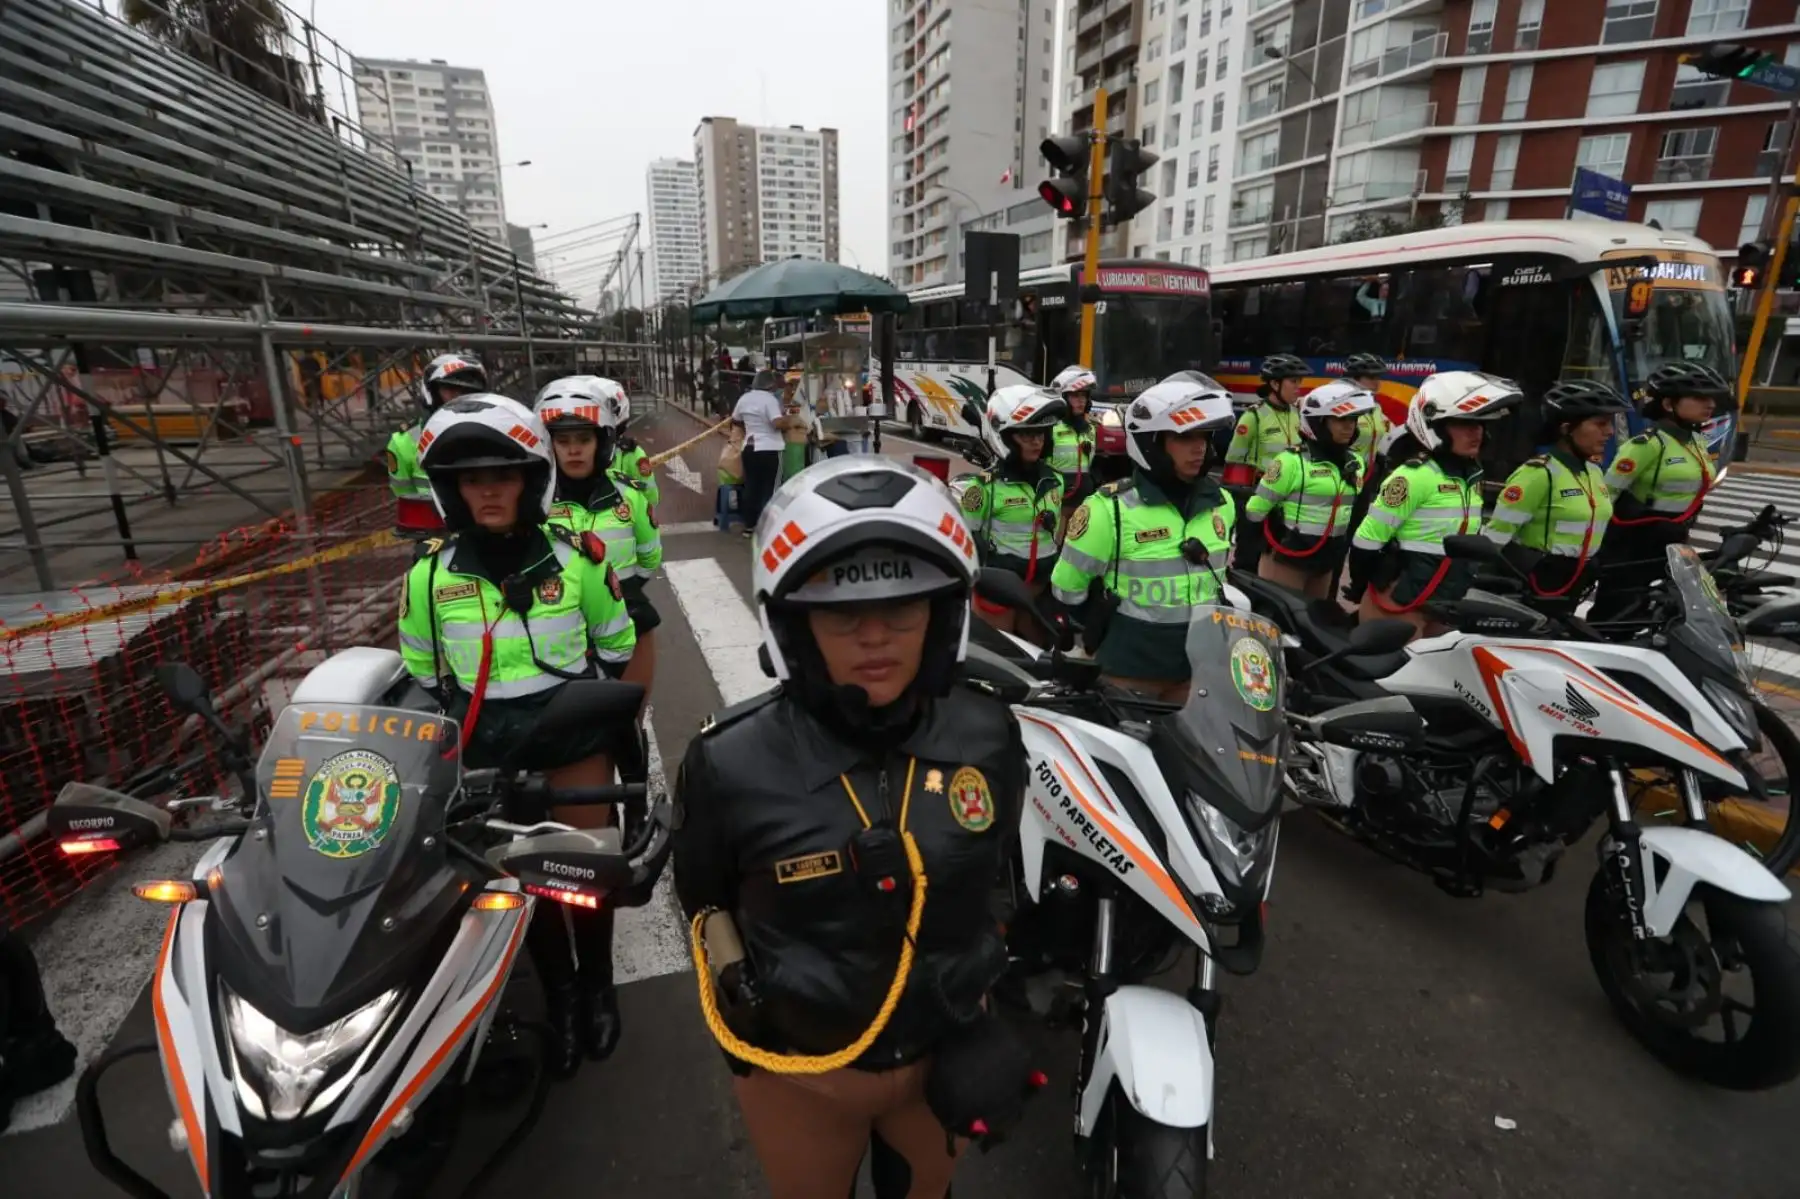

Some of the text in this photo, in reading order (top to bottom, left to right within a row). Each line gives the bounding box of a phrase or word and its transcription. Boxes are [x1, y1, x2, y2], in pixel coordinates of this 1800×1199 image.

[1502, 272, 1552, 286] SUBIDA
[834, 561, 914, 587] POLICIA
[1211, 612, 1280, 640] POLICIA
[301, 711, 436, 741] POLICIA
[1550, 702, 1594, 727] HONDA
[69, 816, 114, 831] ESCORPIO
[1035, 760, 1135, 875] FOTO PAPELETAS
[542, 860, 595, 880] ESCORPIO
